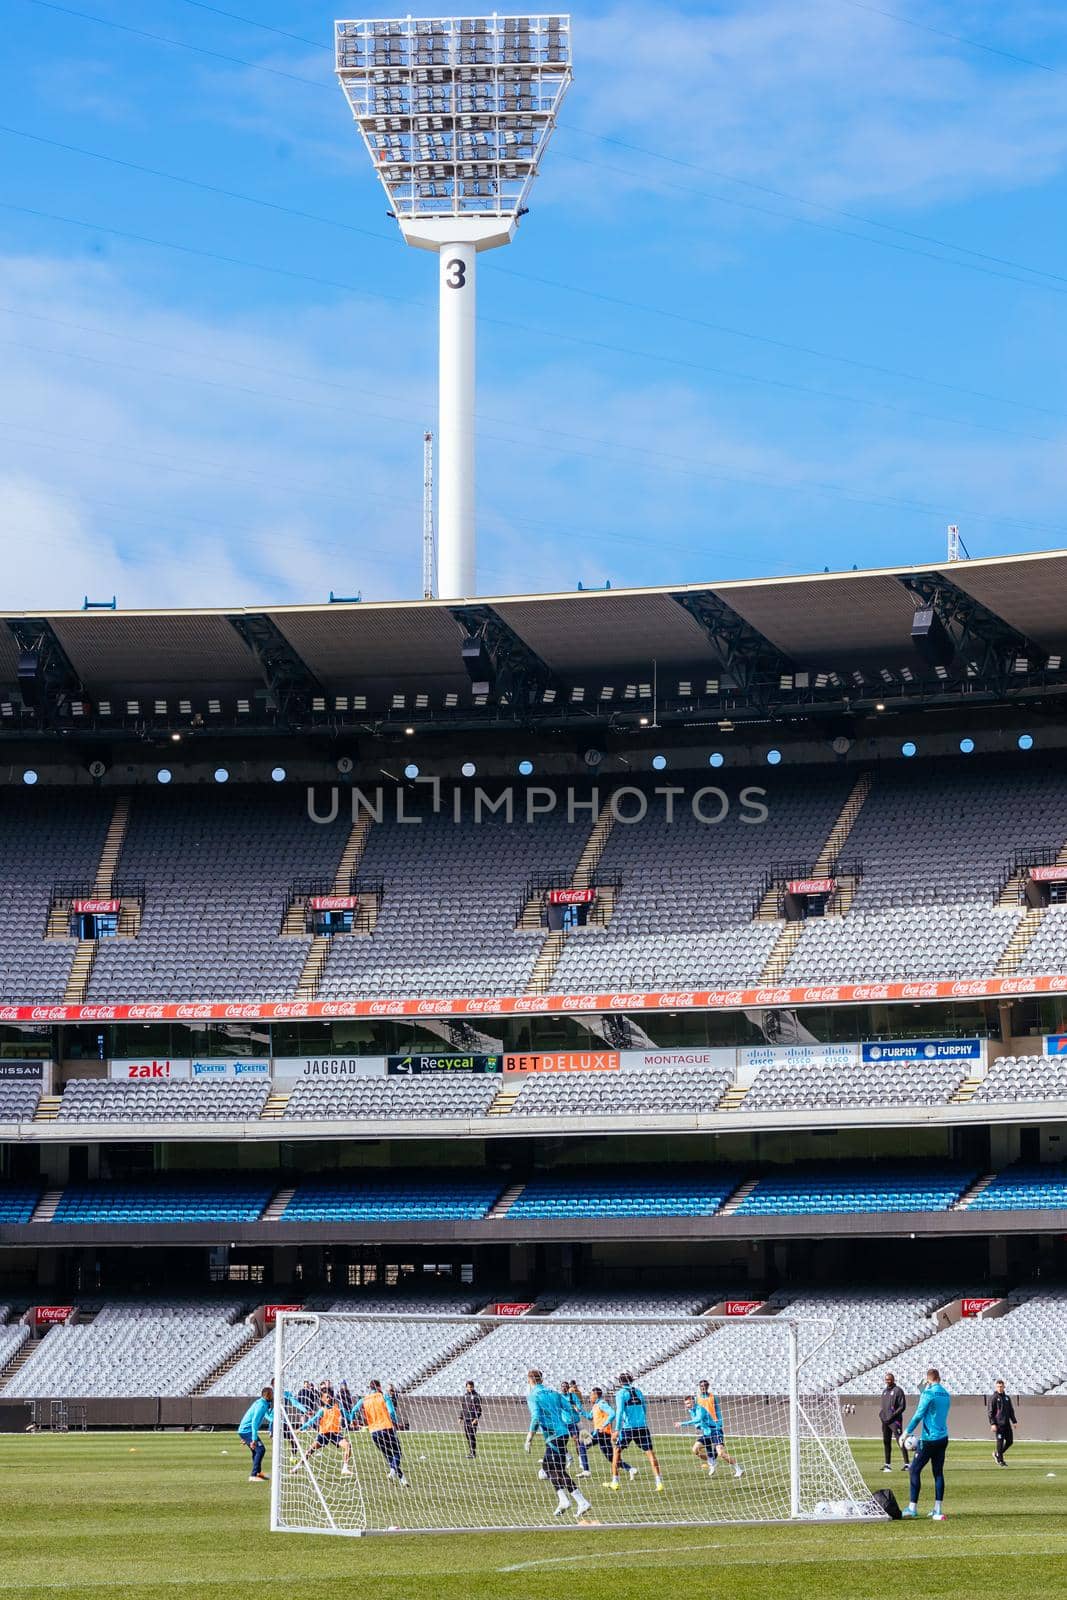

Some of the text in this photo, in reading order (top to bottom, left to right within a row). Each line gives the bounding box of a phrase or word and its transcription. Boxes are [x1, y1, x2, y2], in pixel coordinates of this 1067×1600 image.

[447, 259, 466, 289] 3
[883, 1048, 917, 1057] FURPHY
[938, 1045, 973, 1055] FURPHY
[420, 1057, 474, 1070] Recycal
[644, 1055, 710, 1065] MONTAGUE
[128, 1061, 170, 1078] zak!
[304, 1060, 356, 1075] JAGGAD
